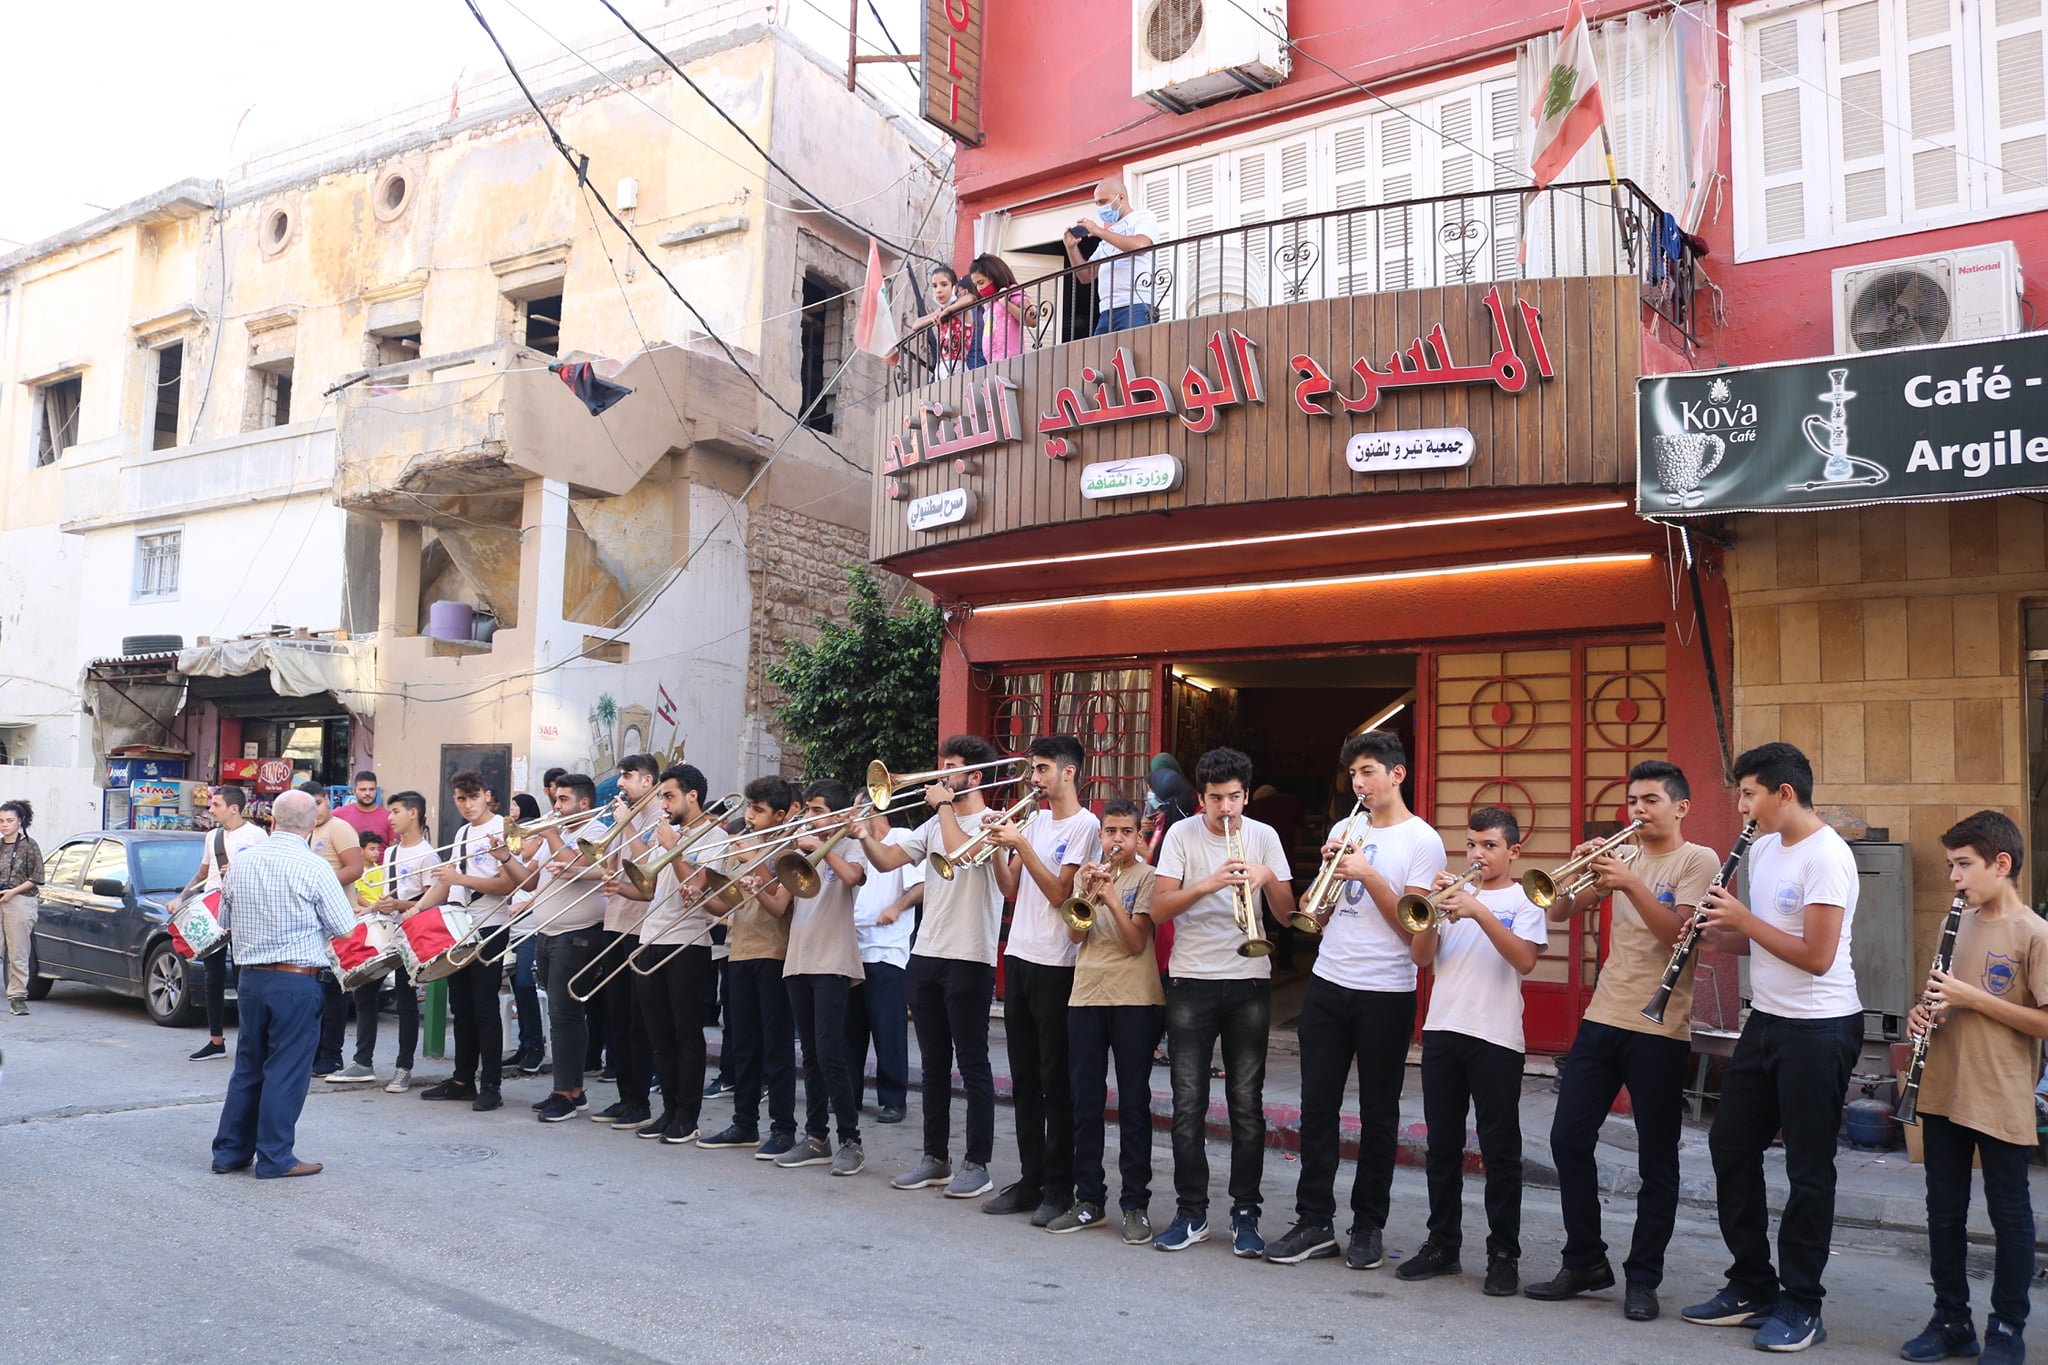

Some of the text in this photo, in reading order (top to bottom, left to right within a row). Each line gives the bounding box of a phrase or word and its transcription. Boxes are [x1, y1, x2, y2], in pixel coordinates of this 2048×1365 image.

[1958, 261, 2001, 274] National
[882, 285, 1554, 499] المسرح الوطني اللبناني
[1904, 364, 2012, 408] Café
[1729, 429, 1757, 443] Café
[1355, 439, 1391, 462] للفنون
[1426, 439, 1463, 458] جمعية
[1087, 470, 1169, 490] وزارة الثقافة
[944, 496, 964, 518] مسرح
